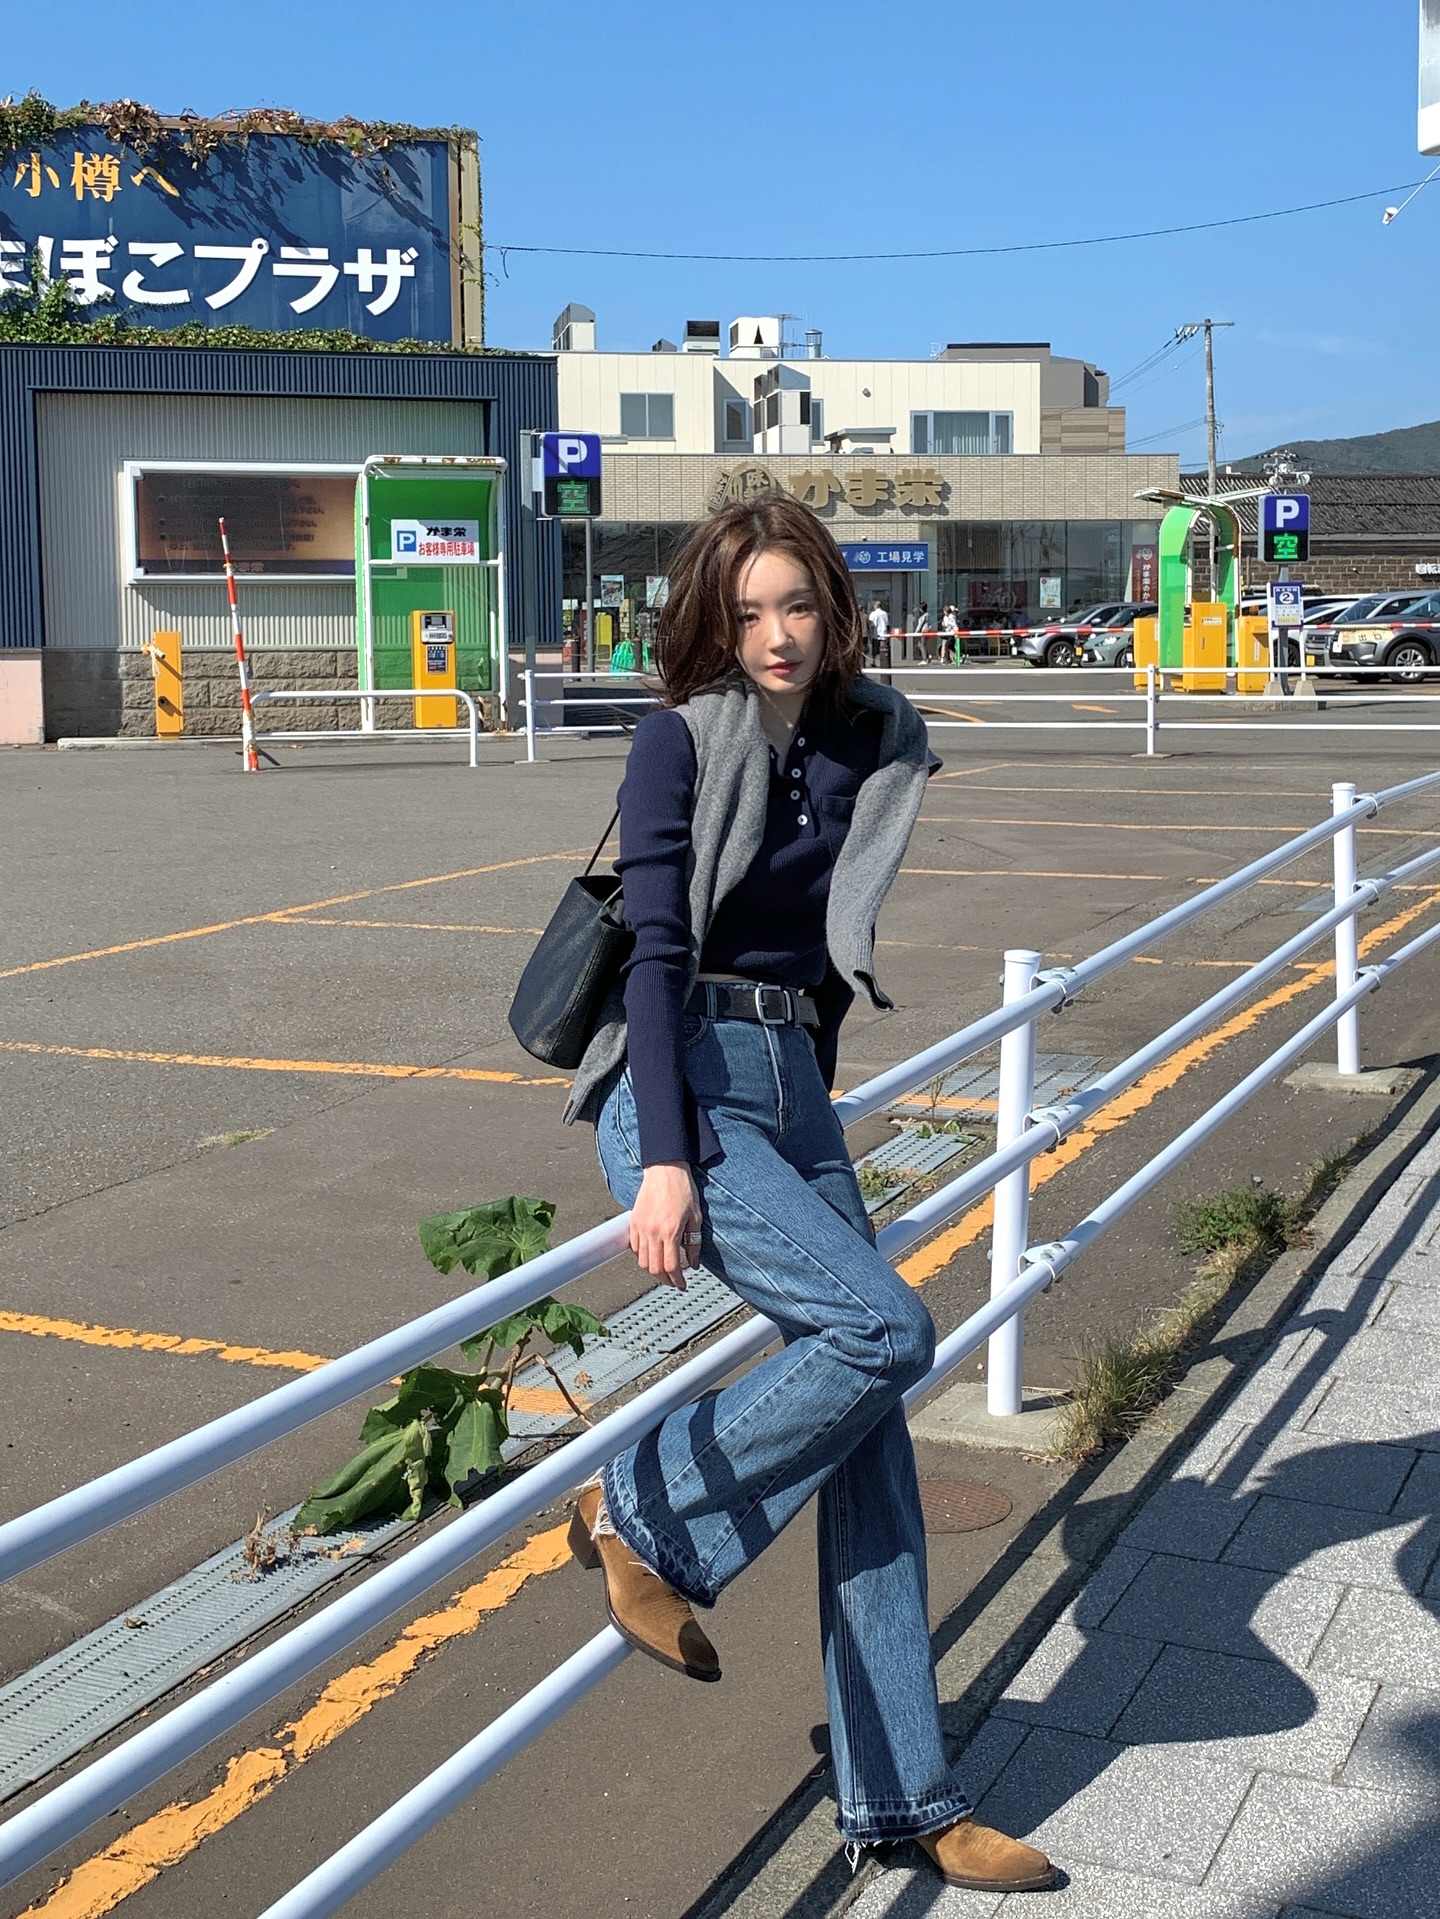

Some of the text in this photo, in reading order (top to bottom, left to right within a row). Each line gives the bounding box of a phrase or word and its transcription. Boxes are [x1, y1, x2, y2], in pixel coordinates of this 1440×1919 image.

[13, 151, 180, 202] 小樽へ
[558, 439, 588, 473] P
[557, 480, 590, 514] 空
[789, 468, 945, 509] かま栄
[1276, 500, 1300, 528] P
[399, 533, 415, 551] P
[426, 526, 467, 537] かま栄
[418, 541, 475, 557] お客様専用駐車場
[877, 550, 925, 563] 工場見学
[1273, 532, 1299, 560] 空
